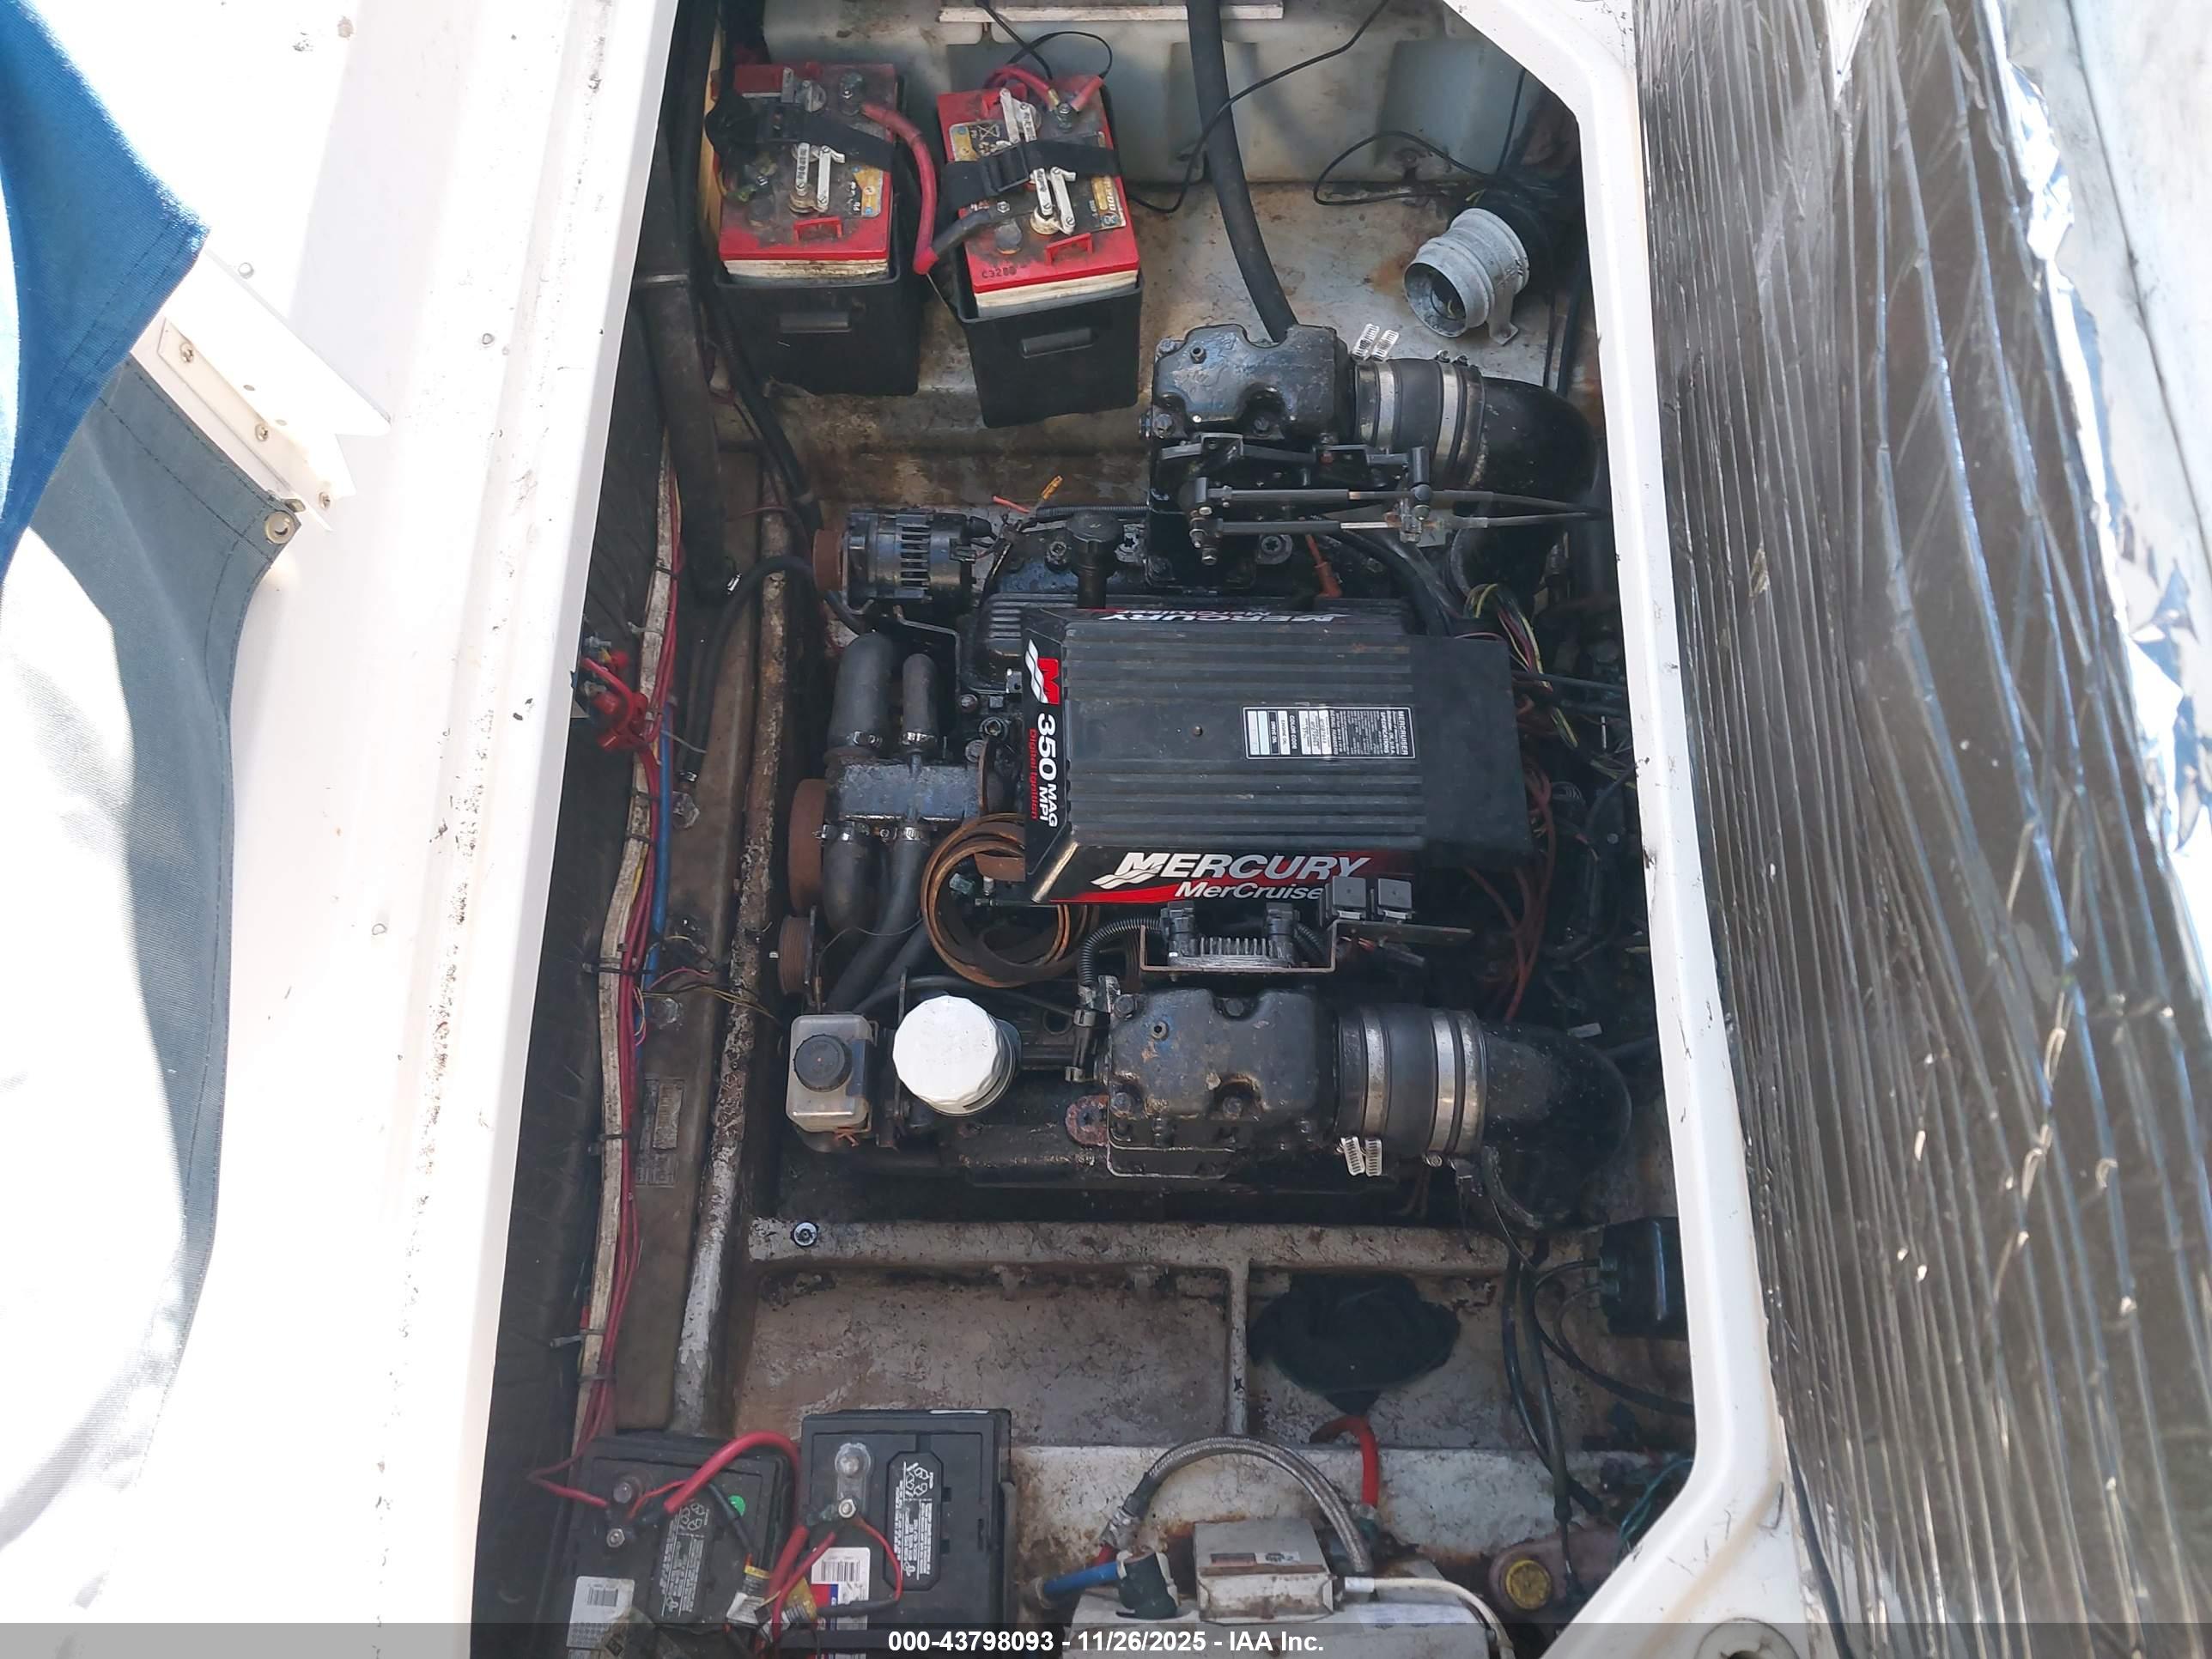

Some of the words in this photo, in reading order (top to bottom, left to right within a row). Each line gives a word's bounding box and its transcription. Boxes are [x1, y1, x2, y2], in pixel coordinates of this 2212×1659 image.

[1028, 727, 1038, 769] Digital
[1380, 711, 1389, 754] SPECIFICATIONS
[1398, 710, 1408, 756] MERCRUISER
[1037, 713, 1057, 780] 350
[1048, 782, 1058, 827] MAG
[1029, 772, 1038, 819] Ignition
[1038, 785, 1048, 821] MPI
[1115, 851, 1372, 880] MERCURY
[1174, 880, 1325, 900] MerCruise
